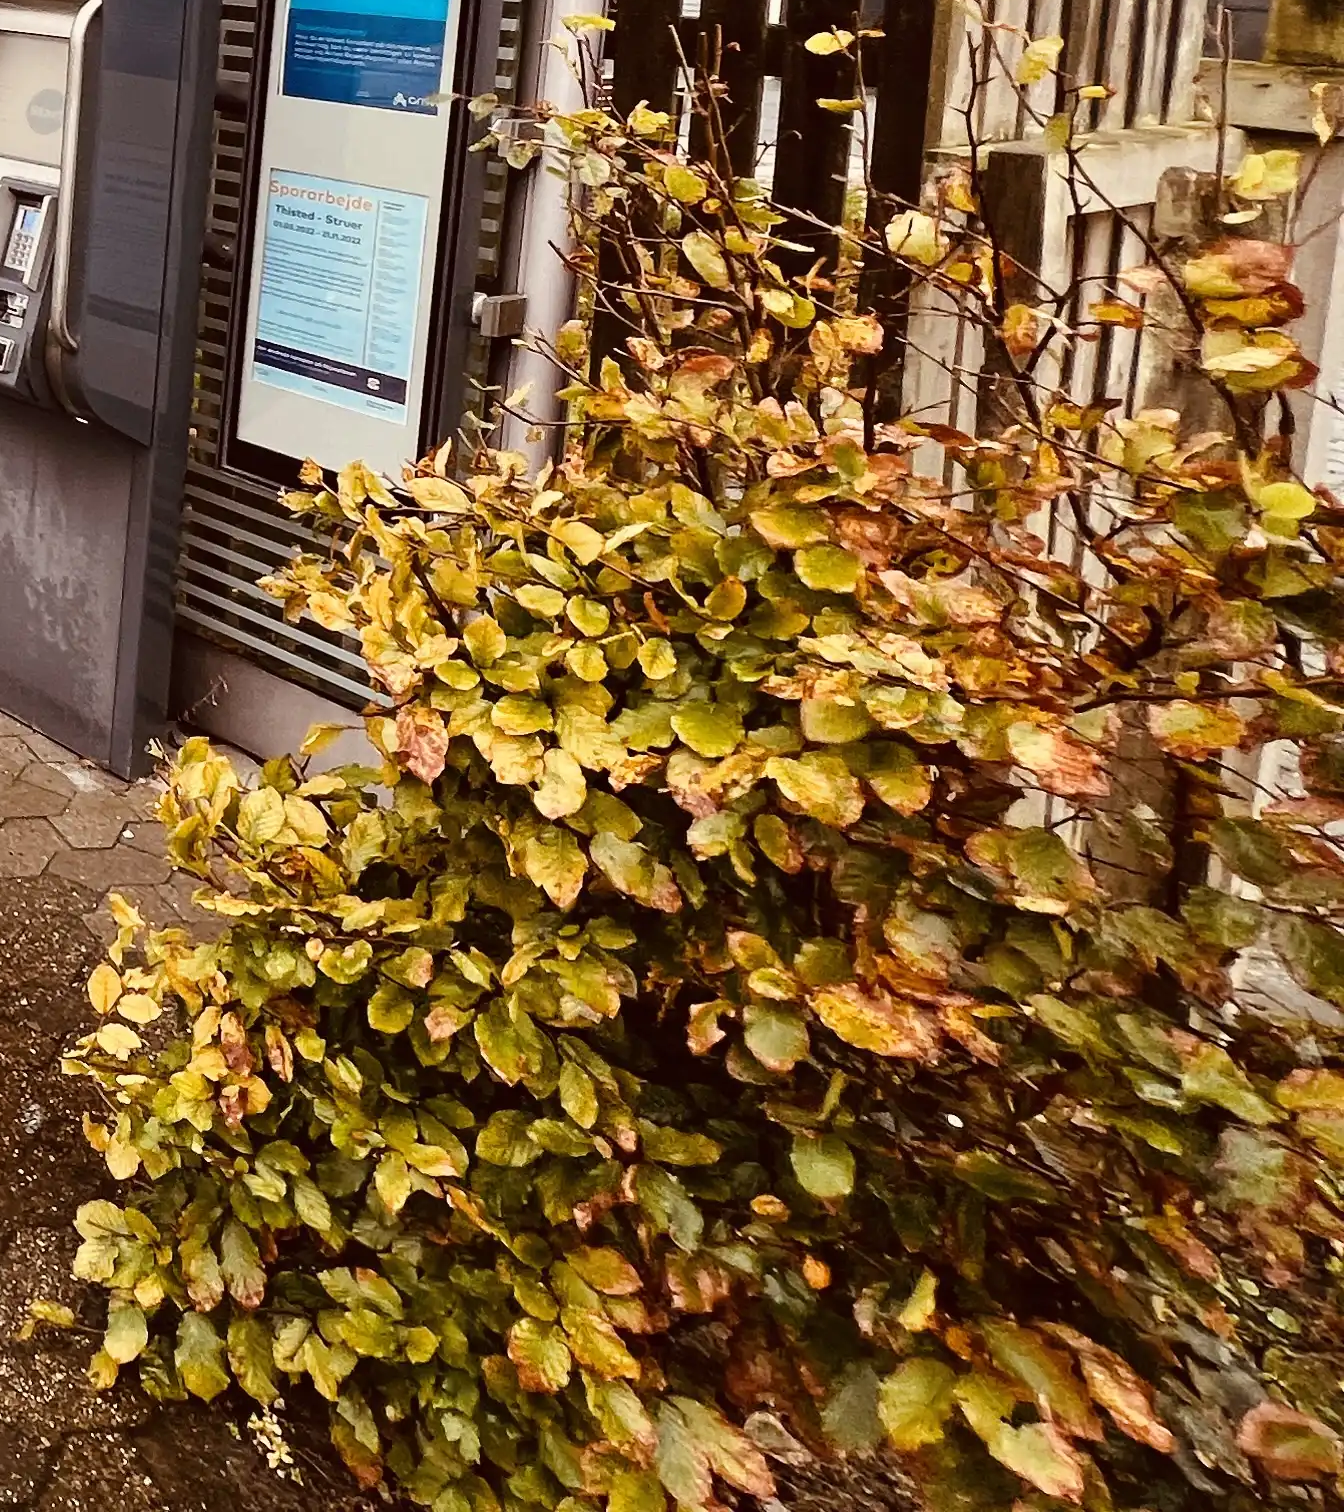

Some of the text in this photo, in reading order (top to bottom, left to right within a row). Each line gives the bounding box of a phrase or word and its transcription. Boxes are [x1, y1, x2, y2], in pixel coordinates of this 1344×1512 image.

[270, 180, 372, 211] Sporarbejde
[275, 204, 315, 220] Thisted
[325, 214, 363, 230] Struer
